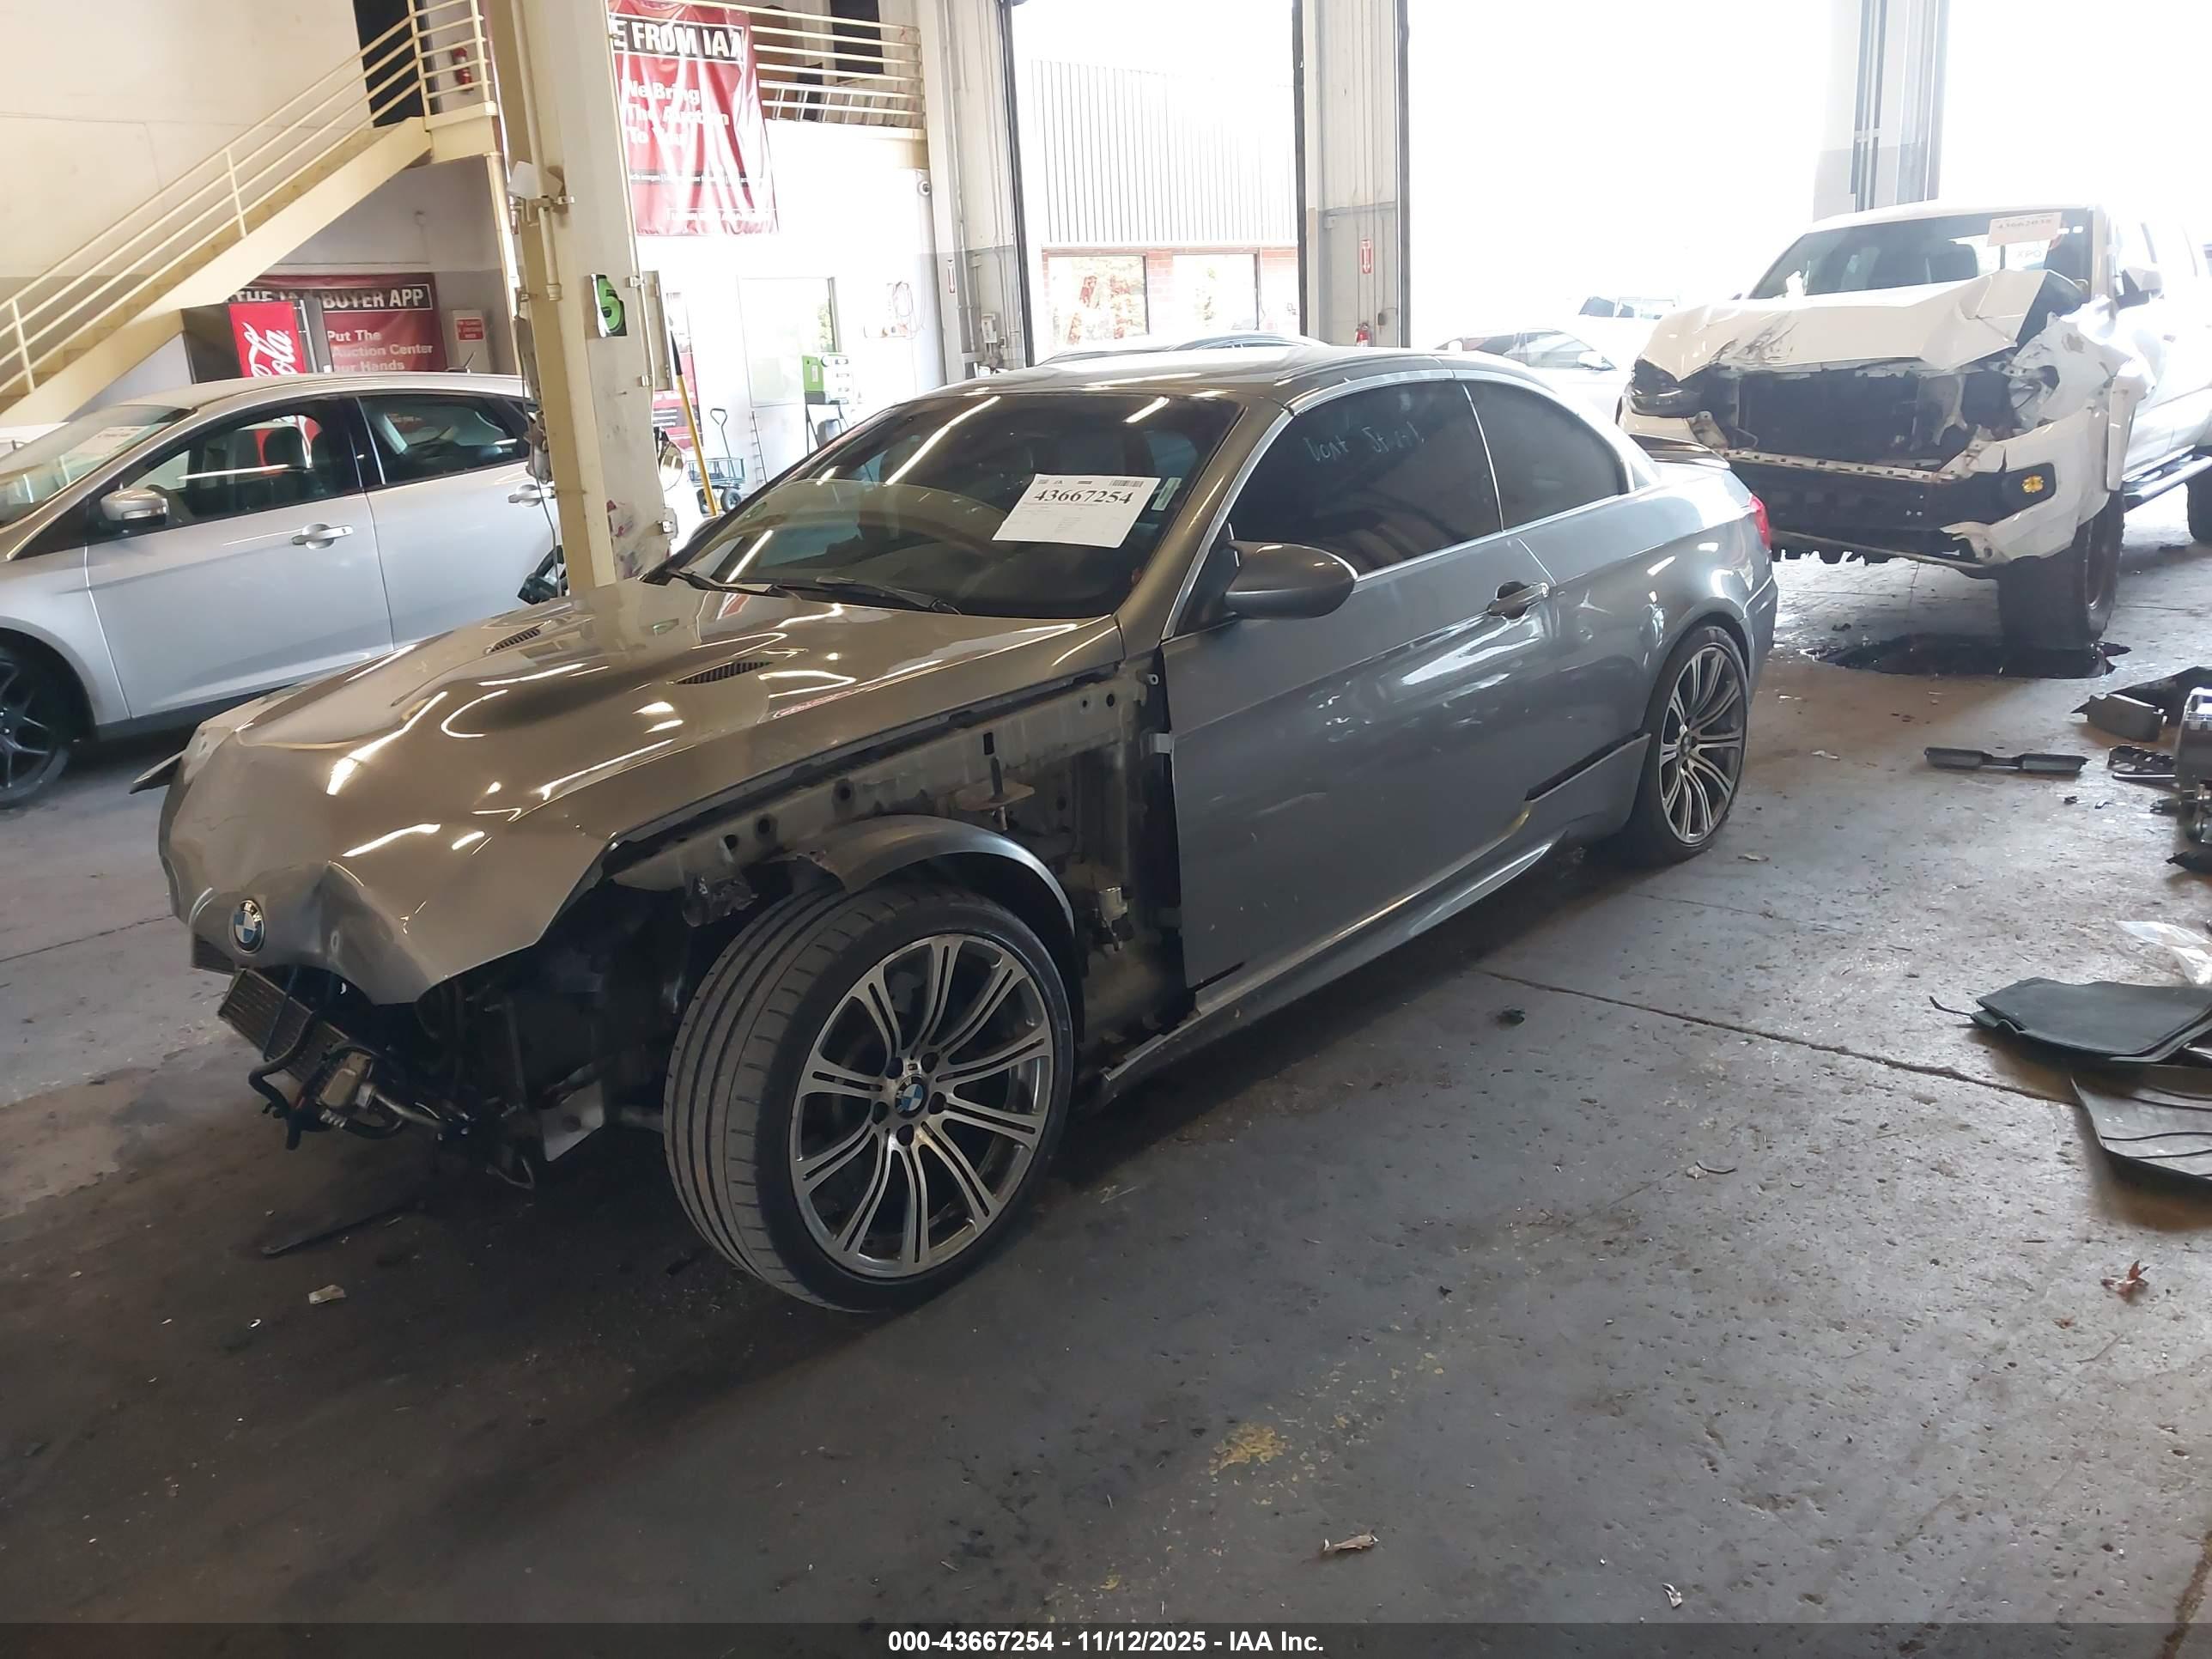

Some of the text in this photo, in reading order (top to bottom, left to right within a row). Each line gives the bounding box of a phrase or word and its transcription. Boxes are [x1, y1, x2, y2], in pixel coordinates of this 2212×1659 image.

[631, 21, 698, 55] FROM
[652, 82, 701, 106] Brng
[323, 292, 385, 309] BUYER
[389, 289, 423, 307] APP
[598, 277, 622, 331] 5
[327, 329, 381, 342] Put The
[331, 343, 434, 358] Auction Center
[361, 360, 405, 373] Hands
[1034, 489, 1134, 505] 43667254
